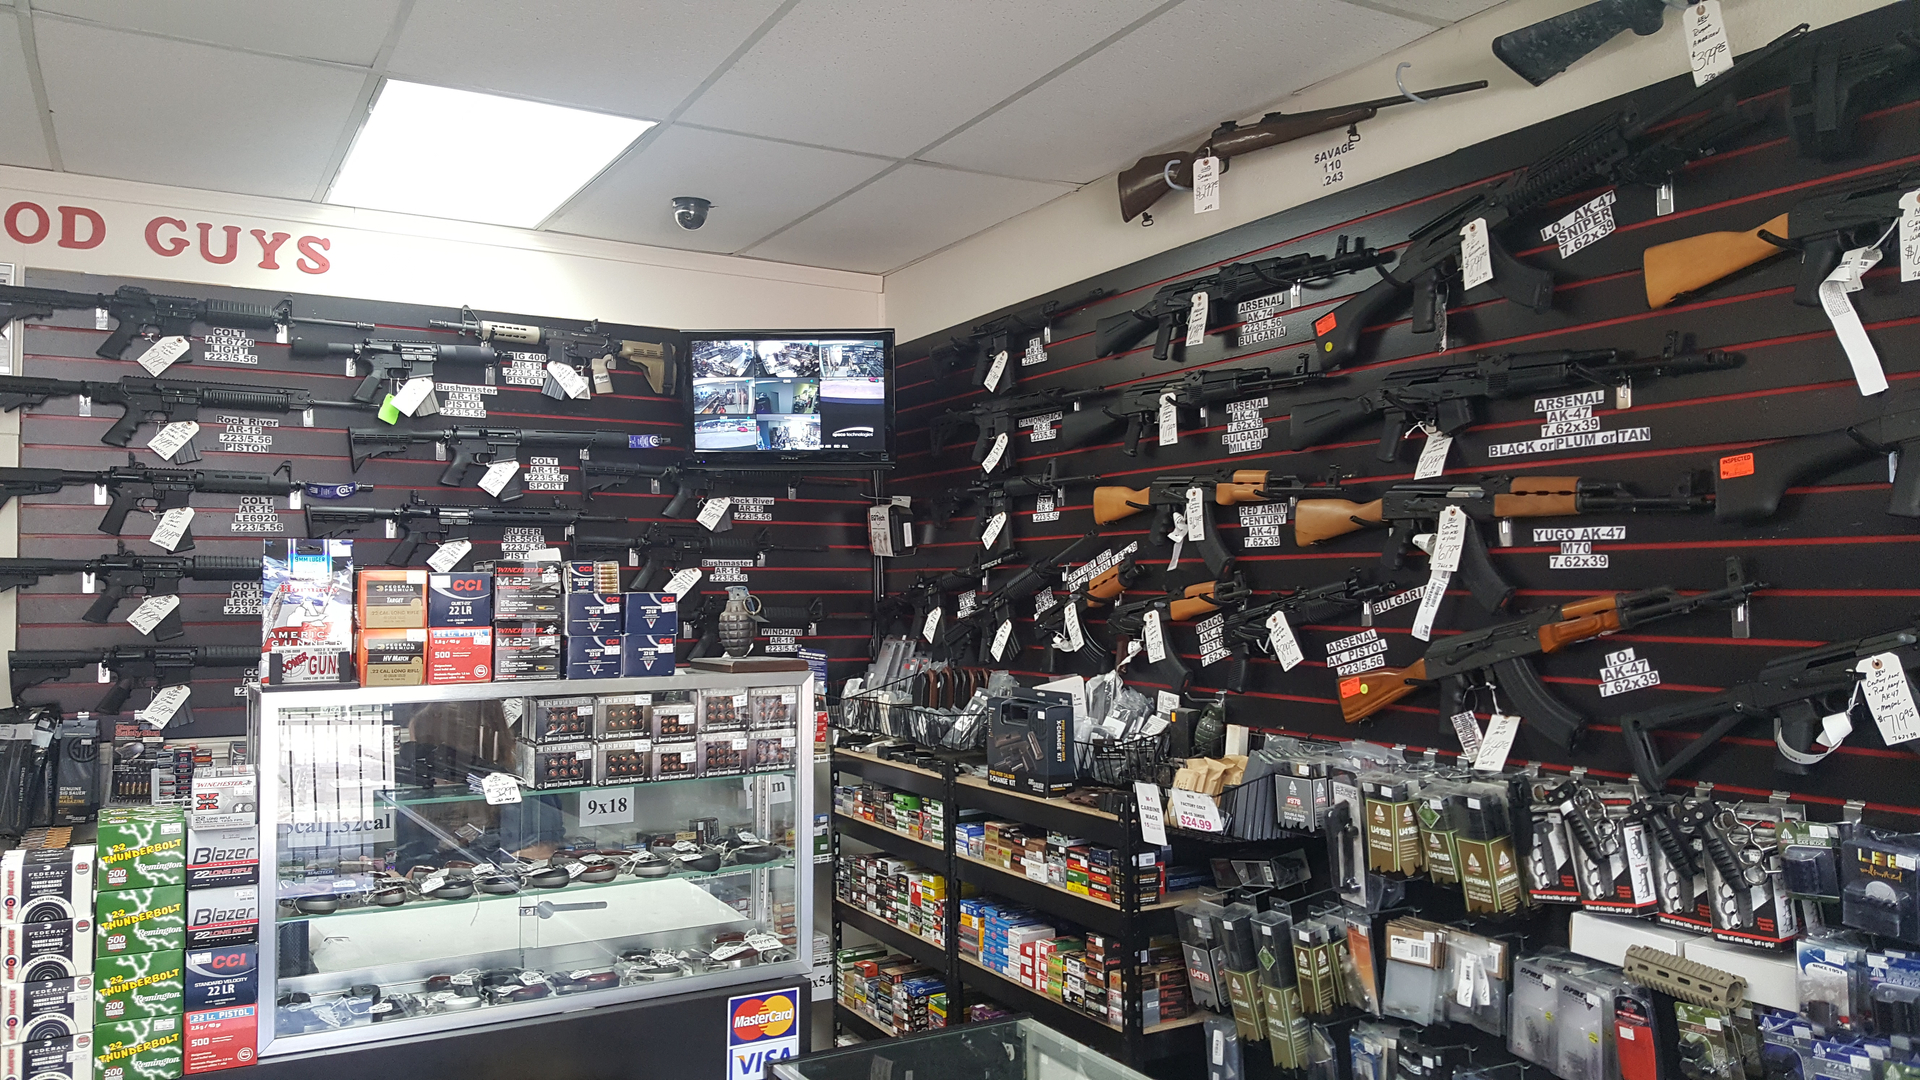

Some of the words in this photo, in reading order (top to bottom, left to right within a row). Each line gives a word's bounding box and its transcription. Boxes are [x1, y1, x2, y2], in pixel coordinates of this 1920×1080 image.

[1314, 141, 1355, 163] SAVAGE
[1323, 160, 1342, 173] 110
[1322, 172, 1344, 187] .243
[1542, 222, 1566, 241] I.O.
[1573, 191, 1615, 223] AK-47
[1559, 207, 1612, 244] SNIPER
[4, 201, 106, 250] OD
[144, 215, 330, 275] GUYS
[1560, 220, 1615, 257] 7.62x39
[1239, 296, 1282, 312] ARSENAL
[1247, 310, 1273, 322] AK-74
[1242, 318, 1282, 333] .223/5.56
[214, 328, 245, 337] COLT
[1239, 328, 1286, 346] BULGARIA
[206, 337, 254, 347] AR-6720
[1030, 338, 1040, 347] ATI
[211, 345, 247, 354] LIGHT
[1027, 346, 1042, 355] AR-15
[205, 353, 257, 363] .223/5.56
[512, 361, 541, 369] AR-15
[503, 369, 547, 377] .223/5.56
[507, 377, 542, 385] PISTOL
[436, 383, 497, 394] Bushmaster
[450, 392, 480, 400] AR-15
[1535, 392, 1603, 411] ARSENAL
[445, 400, 483, 409] PISTOL
[1227, 398, 1268, 413] ARSENAL
[440, 408, 486, 417] .223/5.56
[1232, 410, 1259, 420] AK-47
[1548, 408, 1591, 422] AK-47
[217, 415, 245, 425] Rock
[249, 418, 279, 427] River
[1019, 412, 1062, 427] DIAMONDBACK
[1228, 420, 1263, 431] 7.62x39
[227, 425, 261, 434] AR-15
[1034, 423, 1051, 432] AR-15
[1542, 418, 1599, 436] 7.62x39
[220, 434, 271, 444] .223/5.56
[1223, 429, 1268, 444] BULGARIA
[1490, 442, 1536, 457] BLACK
[1540, 442, 1554, 452] or
[1556, 435, 1596, 449] PLUM
[1601, 434, 1616, 443] or
[1619, 428, 1650, 442] TAN
[225, 443, 268, 452] PISTON
[1229, 440, 1262, 453] MILLED
[1722, 455, 1751, 465] INSPECTED
[531, 466, 559, 474] AR-15
[526, 474, 568, 482] .223/5.56
[336, 485, 353, 497] COLT
[529, 482, 563, 490] SPORT
[1241, 506, 1259, 515] RED
[1261, 504, 1287, 514] ARMY
[235, 514, 277, 522] LE6920
[735, 513, 771, 521] .223/5.56
[1241, 515, 1286, 526] CENTURY
[1250, 527, 1277, 536] AK-47
[1535, 530, 1576, 541] YUGO
[1580, 528, 1624, 539] AK-47
[503, 543, 546, 551] .223/5.56
[1245, 537, 1280, 547] 7.62x39
[1562, 543, 1590, 554] M70
[1068, 560, 1096, 582] CENTURY
[1097, 550, 1112, 564] M92
[1550, 556, 1607, 568] 7.62x39
[1088, 562, 1111, 580] PISTOL
[710, 574, 748, 582] .223/5.56
[453, 579, 483, 591] CCI
[1374, 585, 1427, 614] BULGARIA
[449, 606, 460, 615] 22
[461, 606, 472, 614] LR
[1197, 614, 1223, 633] DRACO
[1327, 630, 1377, 654] ARSENAL
[1327, 655, 1343, 668] AK
[1349, 640, 1387, 661] PISTOL
[1607, 652, 1631, 666] I.O.
[1339, 656, 1383, 676] .223/5.56
[1604, 660, 1647, 681] AK-47
[1600, 672, 1658, 696] 7.62x39
[196, 793, 219, 810] X
[588, 798, 627, 815] 9x18
[1141, 805, 1160, 813] CARBINE
[1181, 815, 1212, 830] $24.99
[102, 838, 182, 864] THUNDERBOLT
[193, 847, 254, 865] Blazer
[138, 861, 183, 871] Remington
[108, 869, 126, 878] 500
[208, 868, 230, 877] LONG
[101, 903, 181, 930] THUNDERBOLT
[194, 908, 255, 925] Blazer
[137, 926, 182, 937] Remington
[212, 953, 246, 969] CCI
[1190, 968, 1210, 982] U479
[1828, 967, 1843, 975] 1951
[99, 968, 180, 996] THUNDERBOLT
[194, 979, 223, 987] STANDARD
[809, 974, 833, 988] x54
[208, 987, 219, 996] 22
[221, 985, 234, 995] LR
[191, 1014, 205, 1022] .22
[219, 1009, 250, 1018] PISTOL
[734, 1008, 793, 1029] MasterCard
[98, 1034, 179, 1062] THUNDERBOLT
[736, 1047, 792, 1075] VISA
